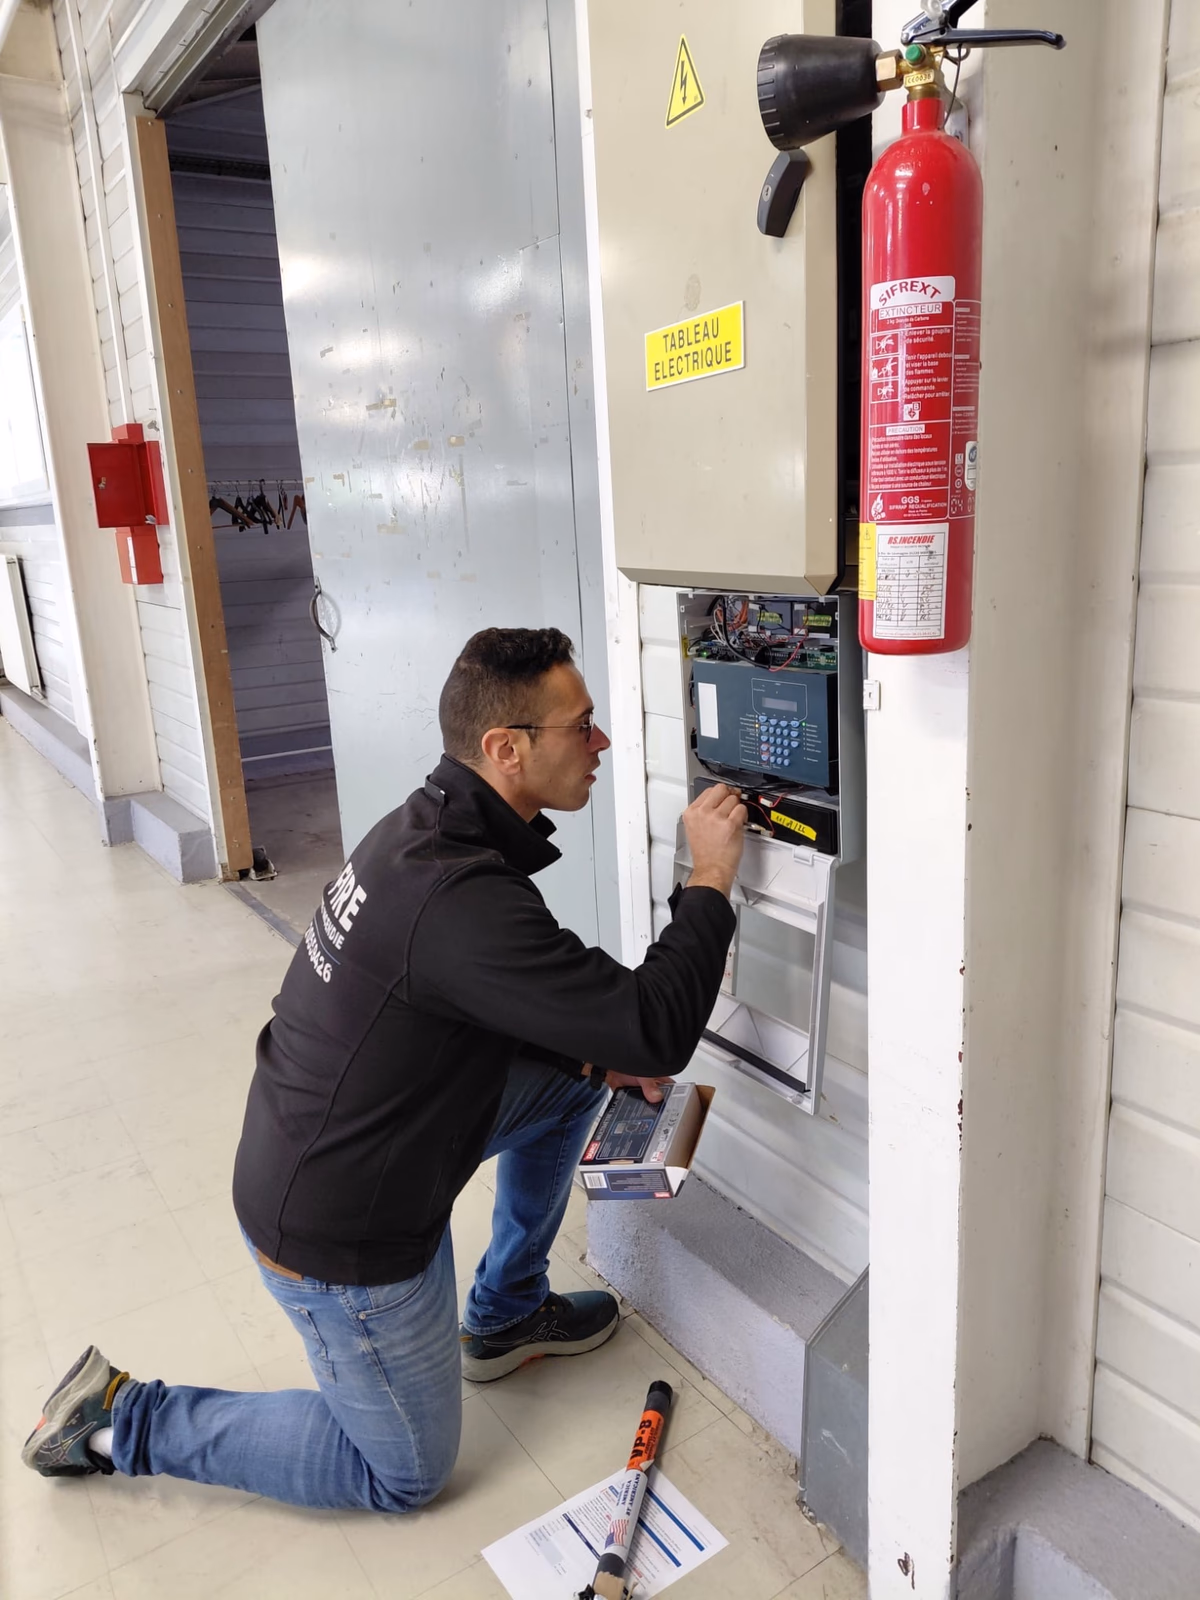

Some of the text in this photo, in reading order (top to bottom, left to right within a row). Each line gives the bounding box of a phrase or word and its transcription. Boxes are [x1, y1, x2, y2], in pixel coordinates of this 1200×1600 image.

[879, 280, 941, 306] SIFREXT
[880, 304, 941, 318] EXTINCTEUR
[662, 317, 719, 353] TABLEAU
[932, 328, 950, 336] goupille
[654, 341, 731, 381] ELECTRIQUE
[901, 496, 920, 504] GGS
[328, 862, 367, 932] FIRE
[621, 1480, 632, 1505] AMERICA
[629, 1473, 641, 1506] AMERICANS
